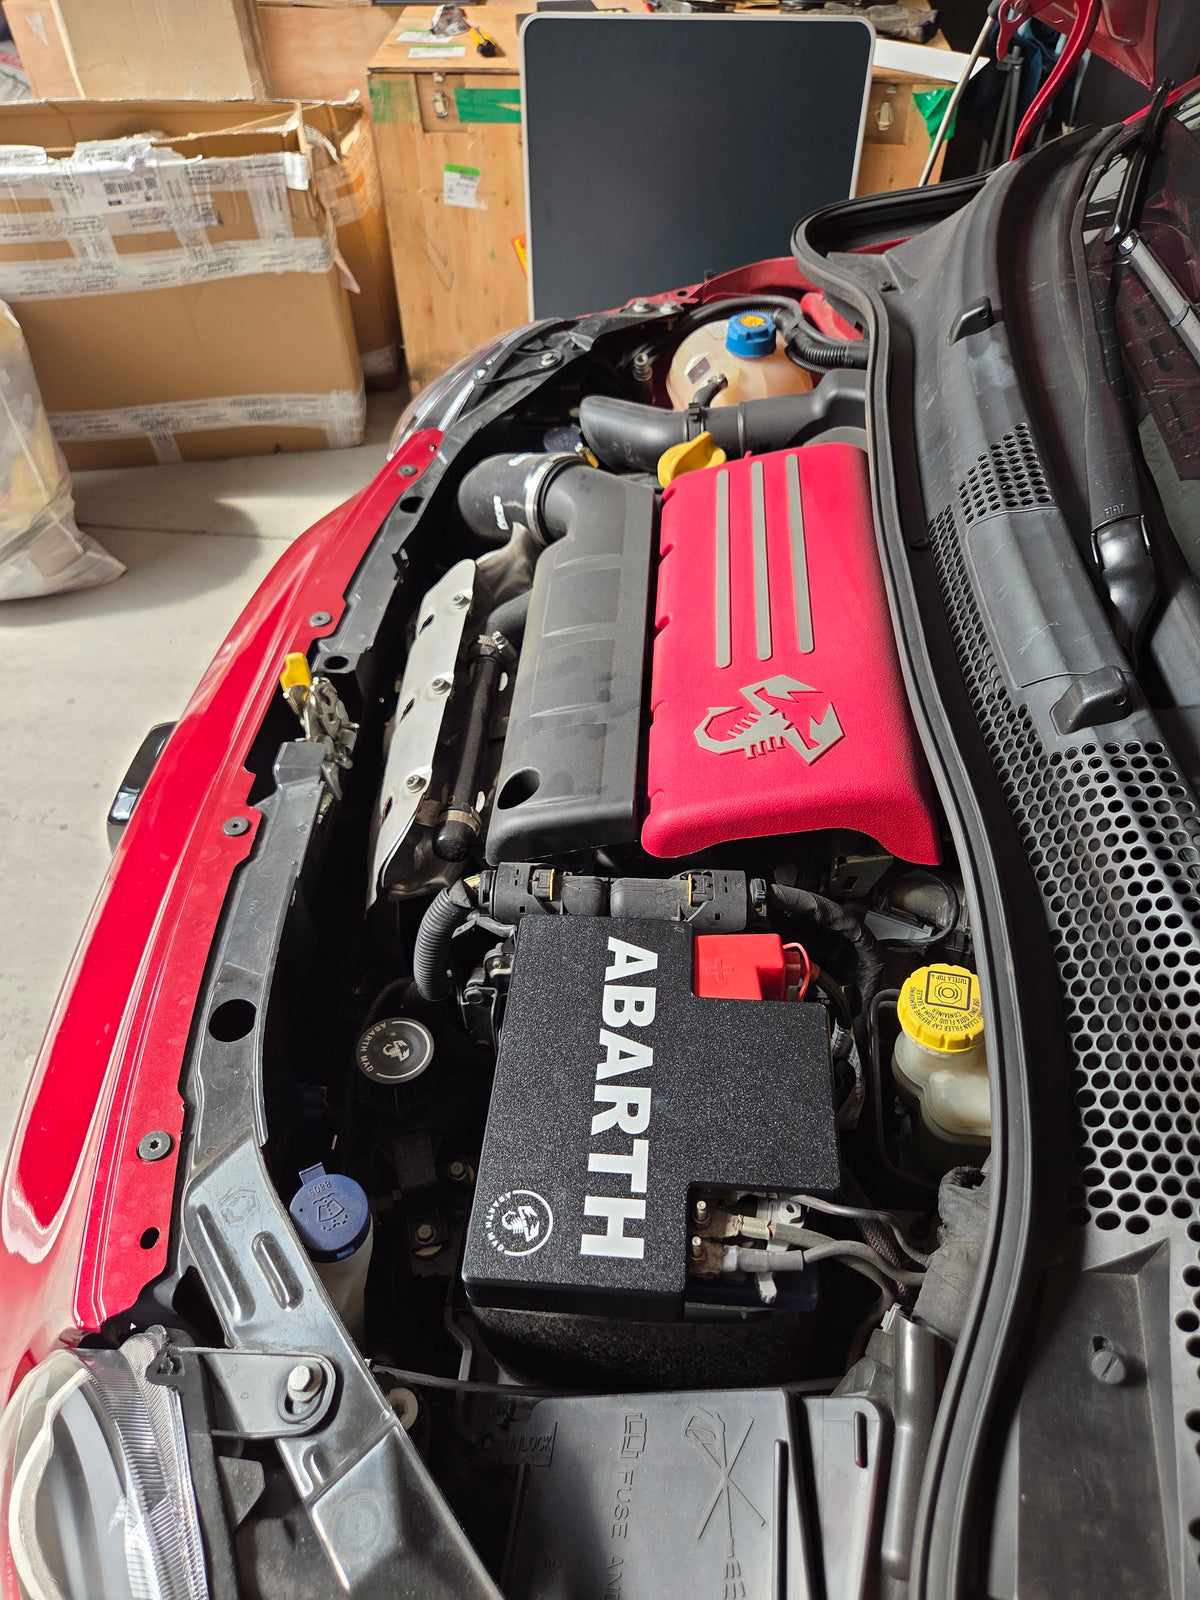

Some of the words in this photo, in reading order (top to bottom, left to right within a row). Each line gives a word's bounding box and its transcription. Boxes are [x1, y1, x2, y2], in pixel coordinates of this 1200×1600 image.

[1104, 503, 1125, 517] FIAT
[947, 976, 967, 984] TUTELA
[914, 1009, 932, 1025] BEFORE
[924, 1009, 938, 1022] FROM
[932, 1008, 962, 1018] CONTAINER
[963, 1018, 979, 1030] CLEAN
[359, 1022, 387, 1052] ABARTH
[360, 1055, 374, 1072] MAD
[580, 936, 658, 1260] ABARTH
[485, 1191, 511, 1229] ABARTH
[487, 1231, 505, 1252] MAD
[505, 1434, 553, 1452] UNLOCK
[610, 1470, 634, 1539] FUSE
